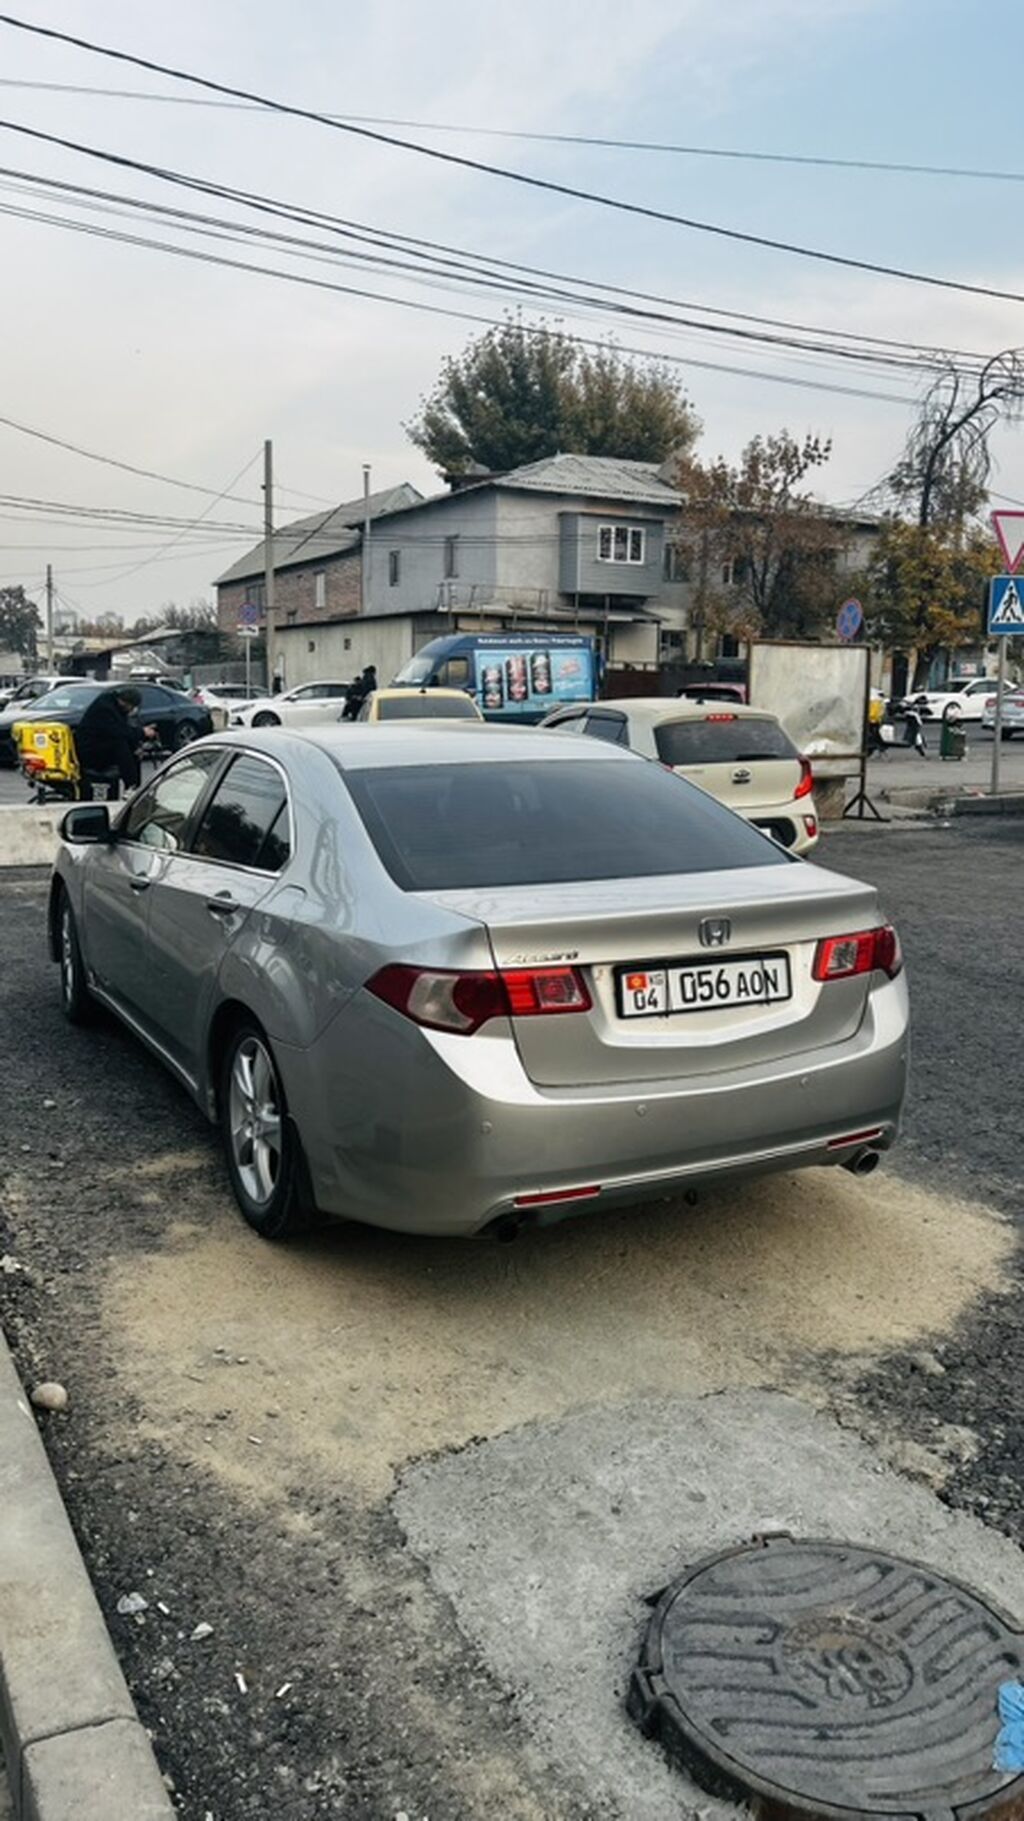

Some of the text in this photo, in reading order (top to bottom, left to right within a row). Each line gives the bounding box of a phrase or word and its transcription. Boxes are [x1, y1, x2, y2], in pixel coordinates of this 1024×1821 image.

[633, 968, 779, 1011] 04 056 AON
[650, 974, 664, 986] KG
